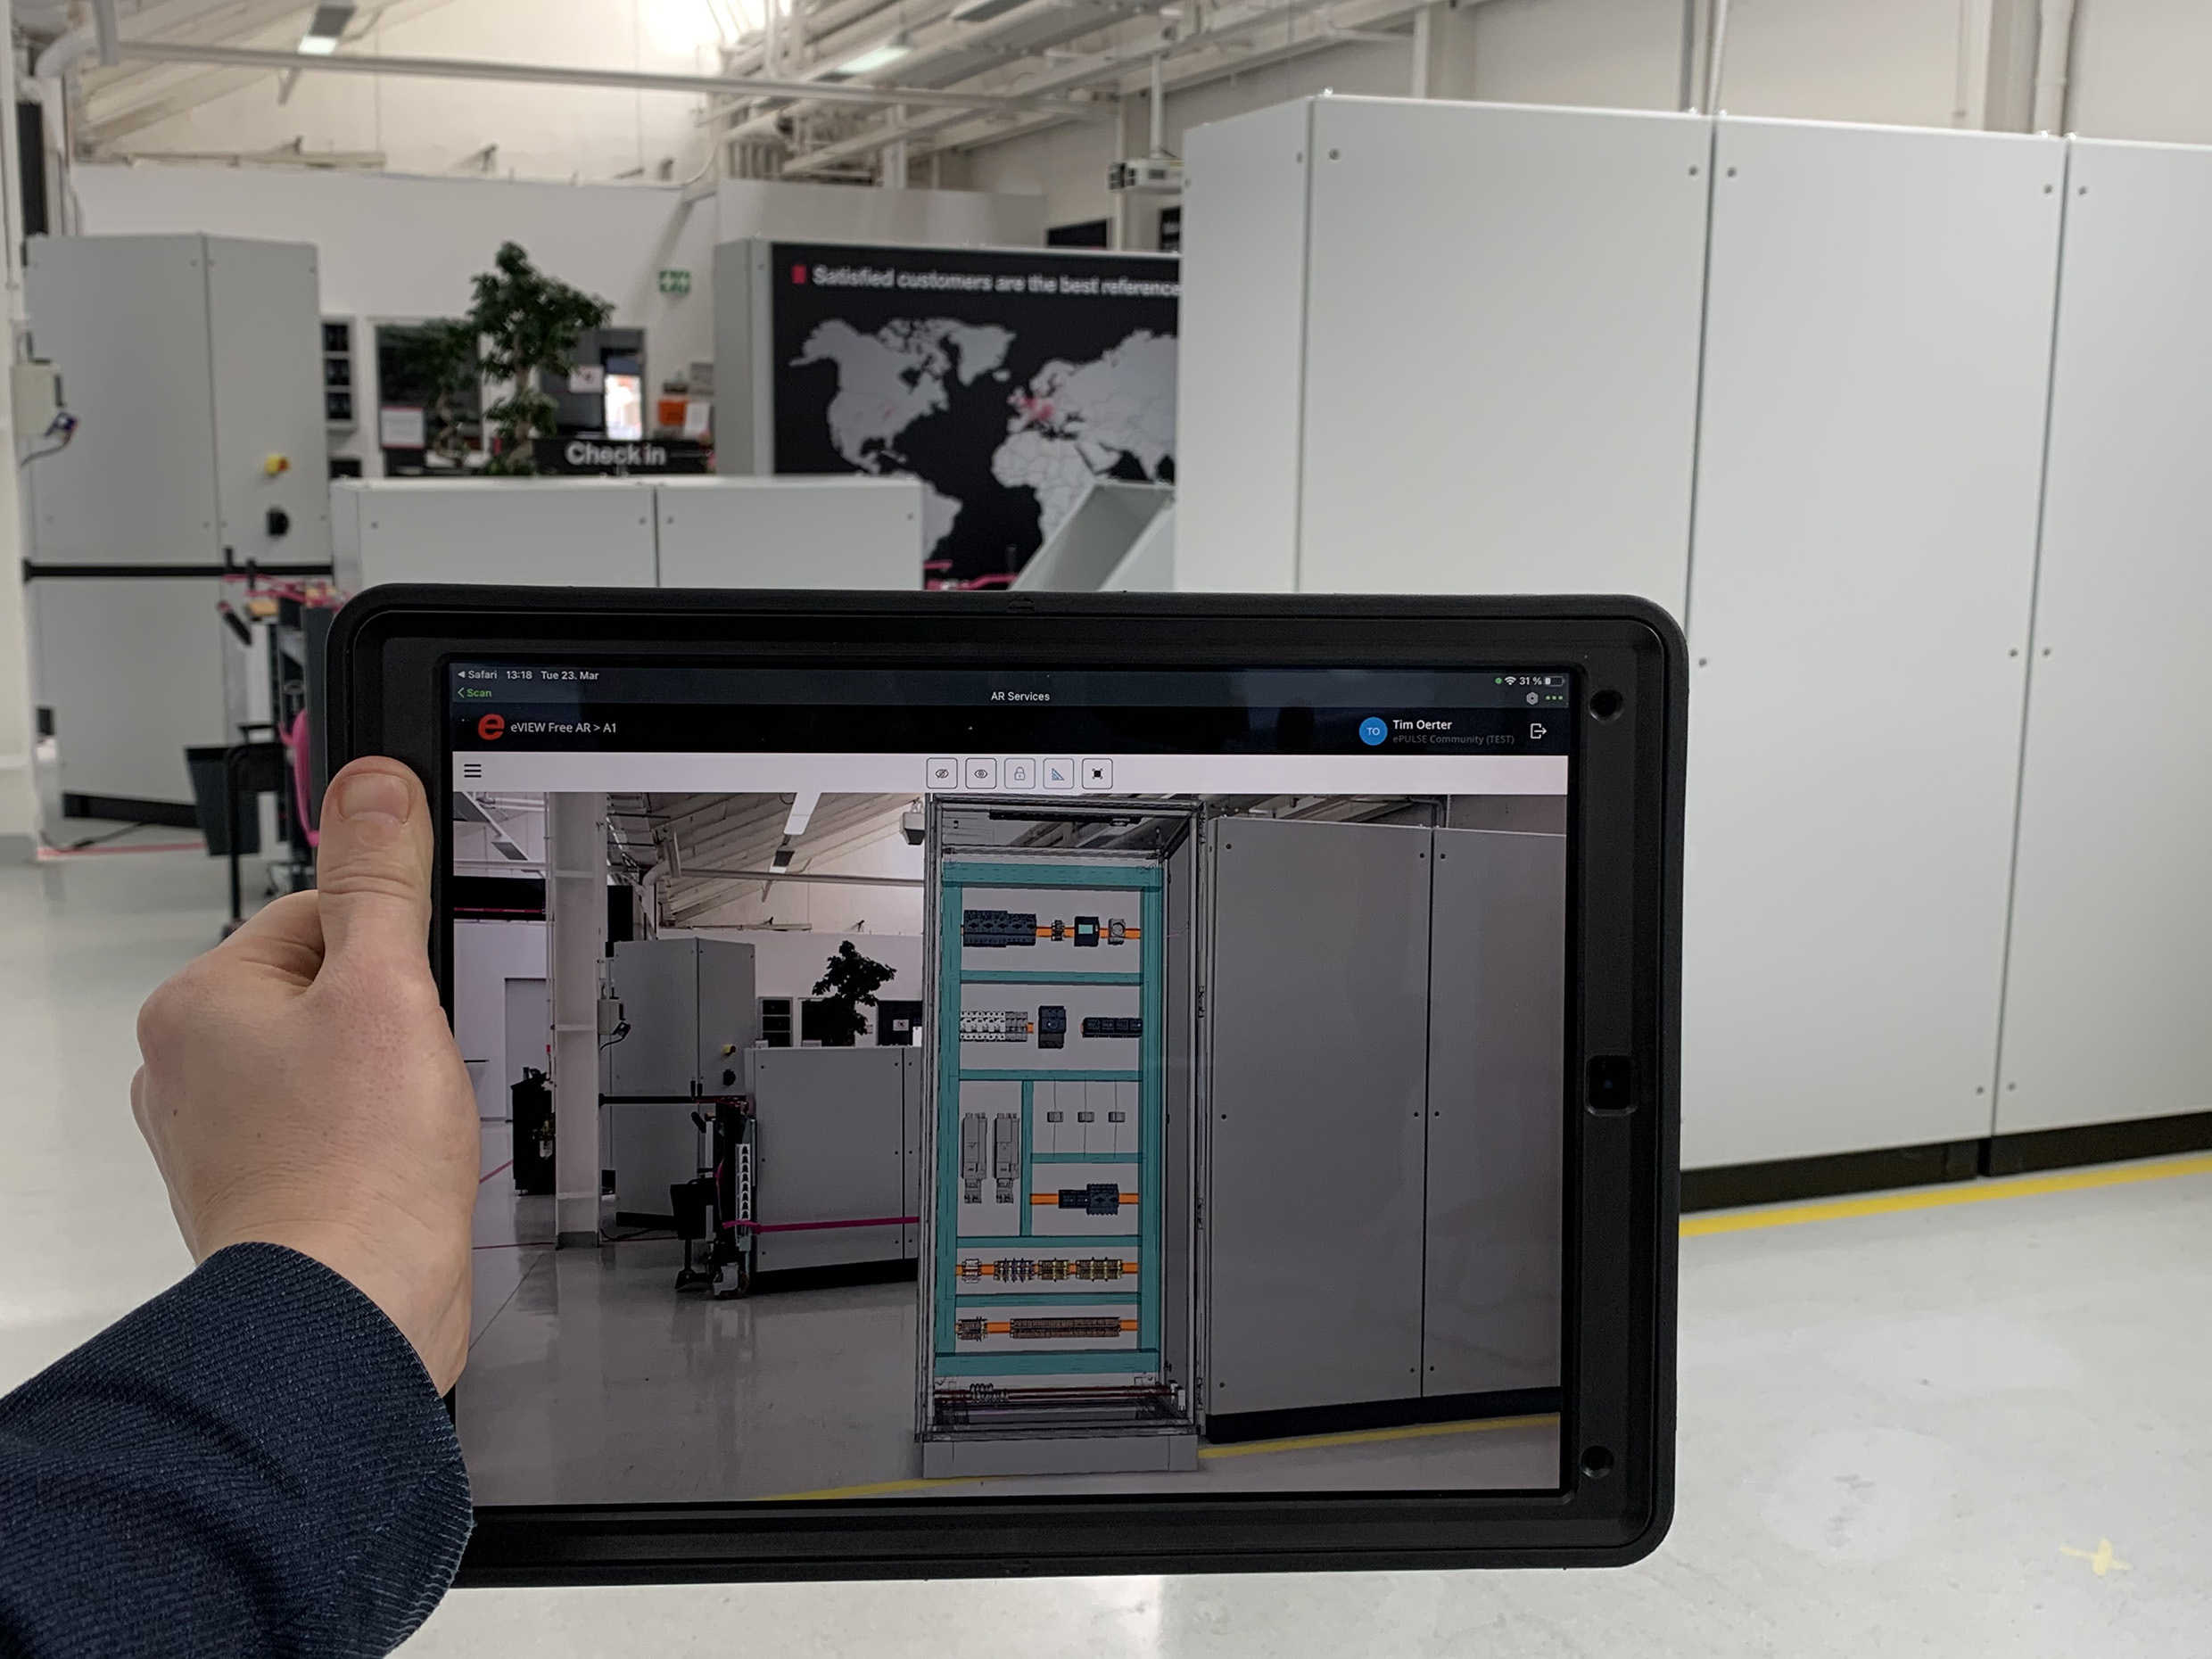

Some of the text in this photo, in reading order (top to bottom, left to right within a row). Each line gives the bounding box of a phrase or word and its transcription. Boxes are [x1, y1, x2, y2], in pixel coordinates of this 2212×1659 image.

[812, 264, 895, 286] Satisfied
[896, 270, 994, 291] customers
[995, 276, 1026, 293] are
[1028, 274, 1058, 293] the
[1060, 275, 1100, 294] best
[565, 441, 667, 466] Check in
[468, 671, 498, 680] Safari
[506, 671, 532, 680] 13:18
[541, 671, 599, 681] Tue 23. Mar
[1519, 677, 1531, 686] 31
[466, 689, 492, 697] Scan
[990, 691, 1051, 701] AR Services
[510, 722, 545, 732] eVIEW
[549, 722, 574, 733] Free
[575, 723, 591, 733] AR
[603, 723, 616, 733] A1
[1392, 719, 1452, 730] Tim Oerter
[1366, 727, 1381, 736] TO
[1392, 734, 1515, 745] ePULSE Community (TEST)
